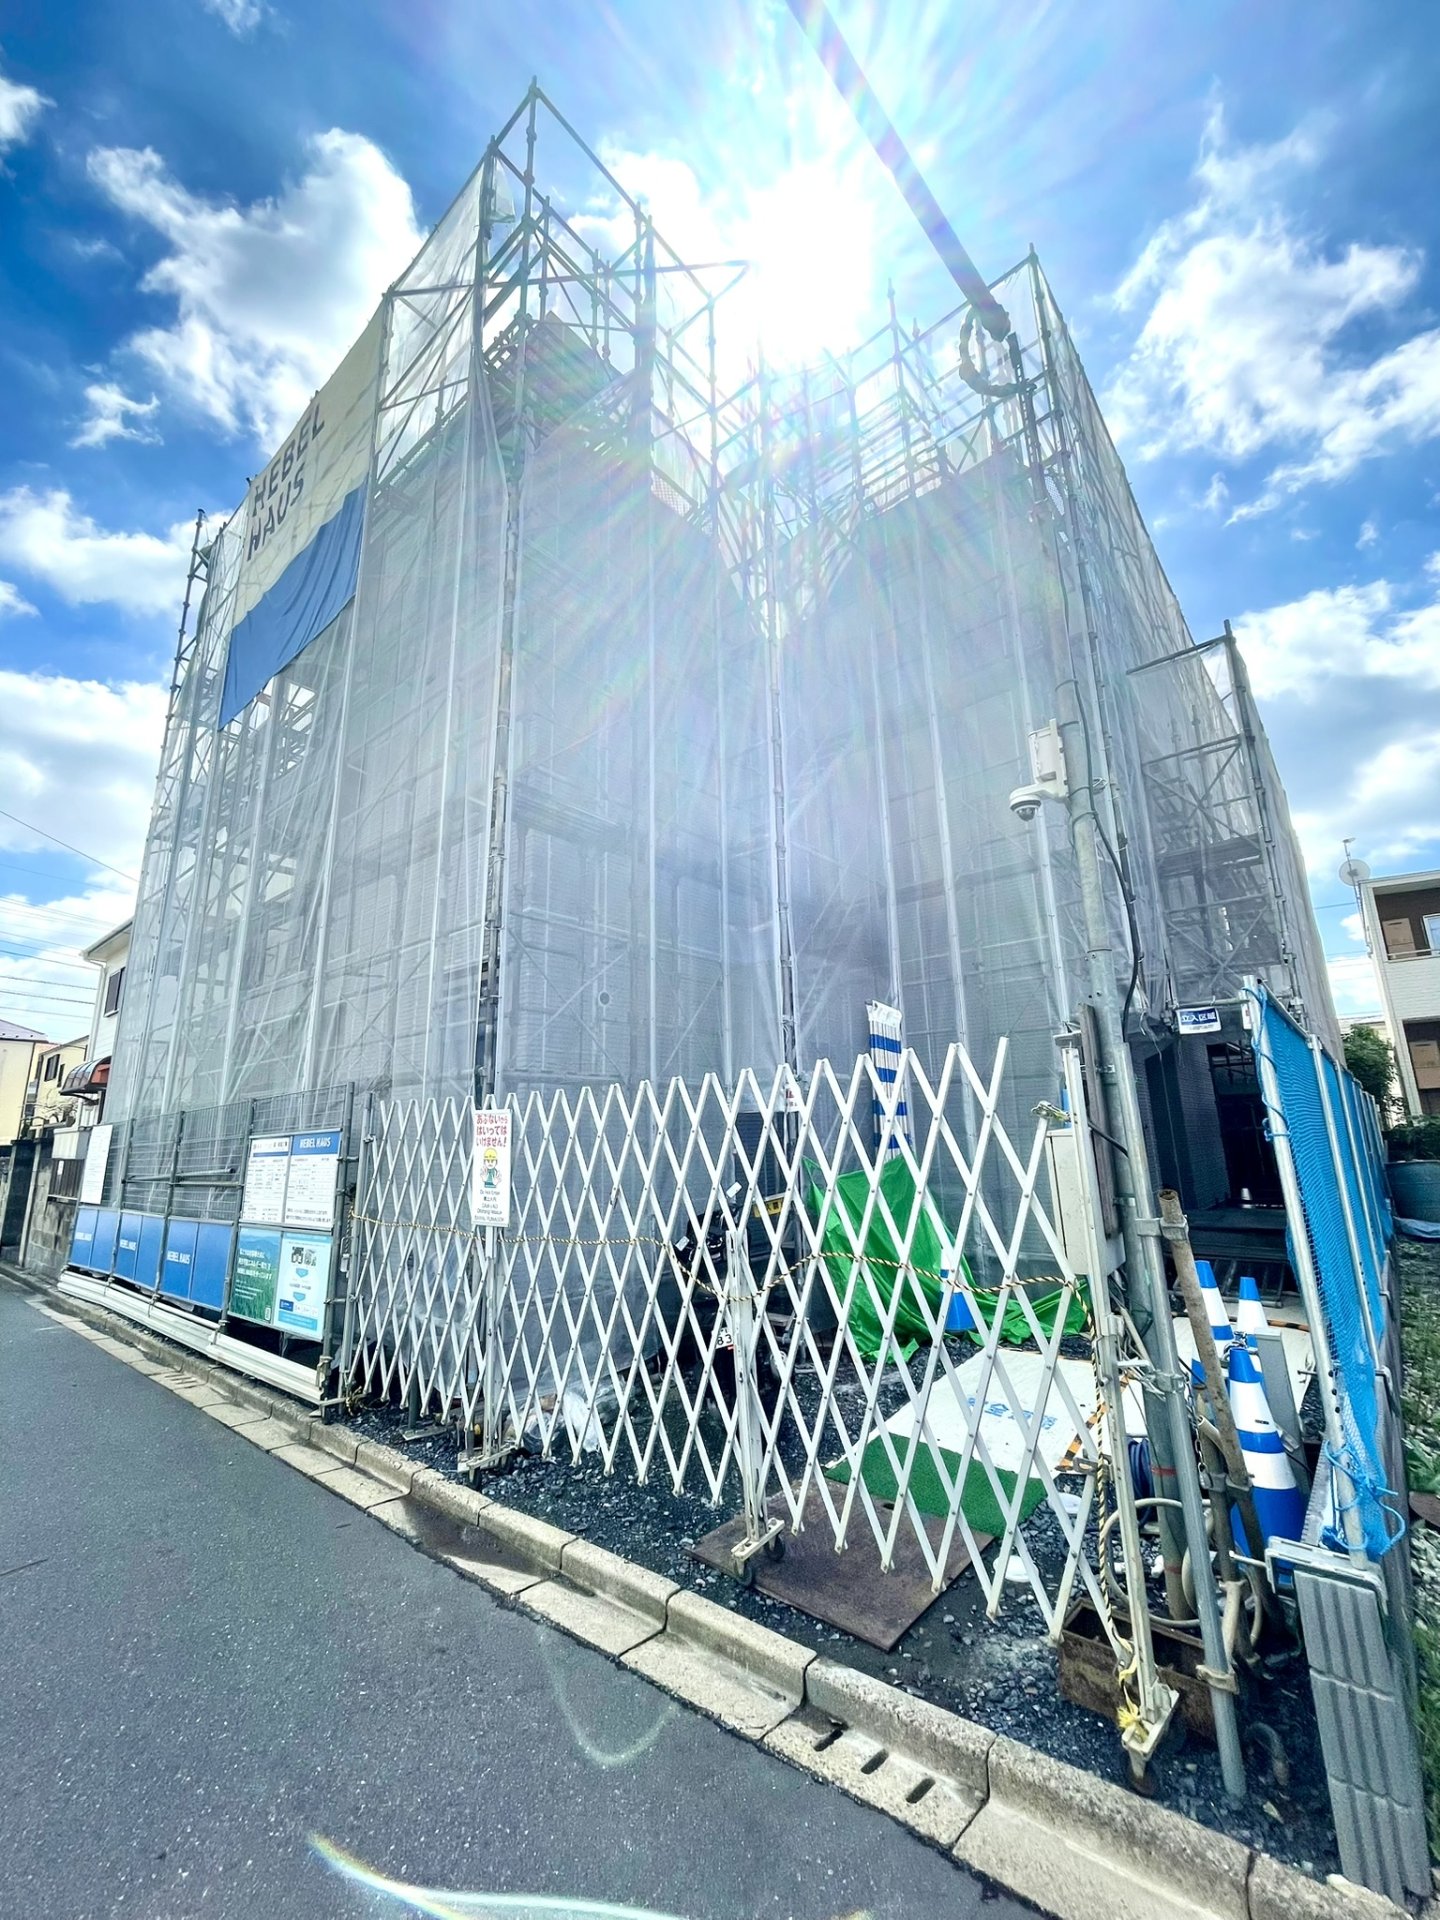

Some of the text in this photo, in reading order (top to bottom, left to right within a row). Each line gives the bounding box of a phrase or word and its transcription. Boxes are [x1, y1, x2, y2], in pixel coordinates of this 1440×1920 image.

[252, 402, 325, 517] HEBEL
[247, 462, 306, 562] HAUS
[476, 1125, 508, 1136] はいっては
